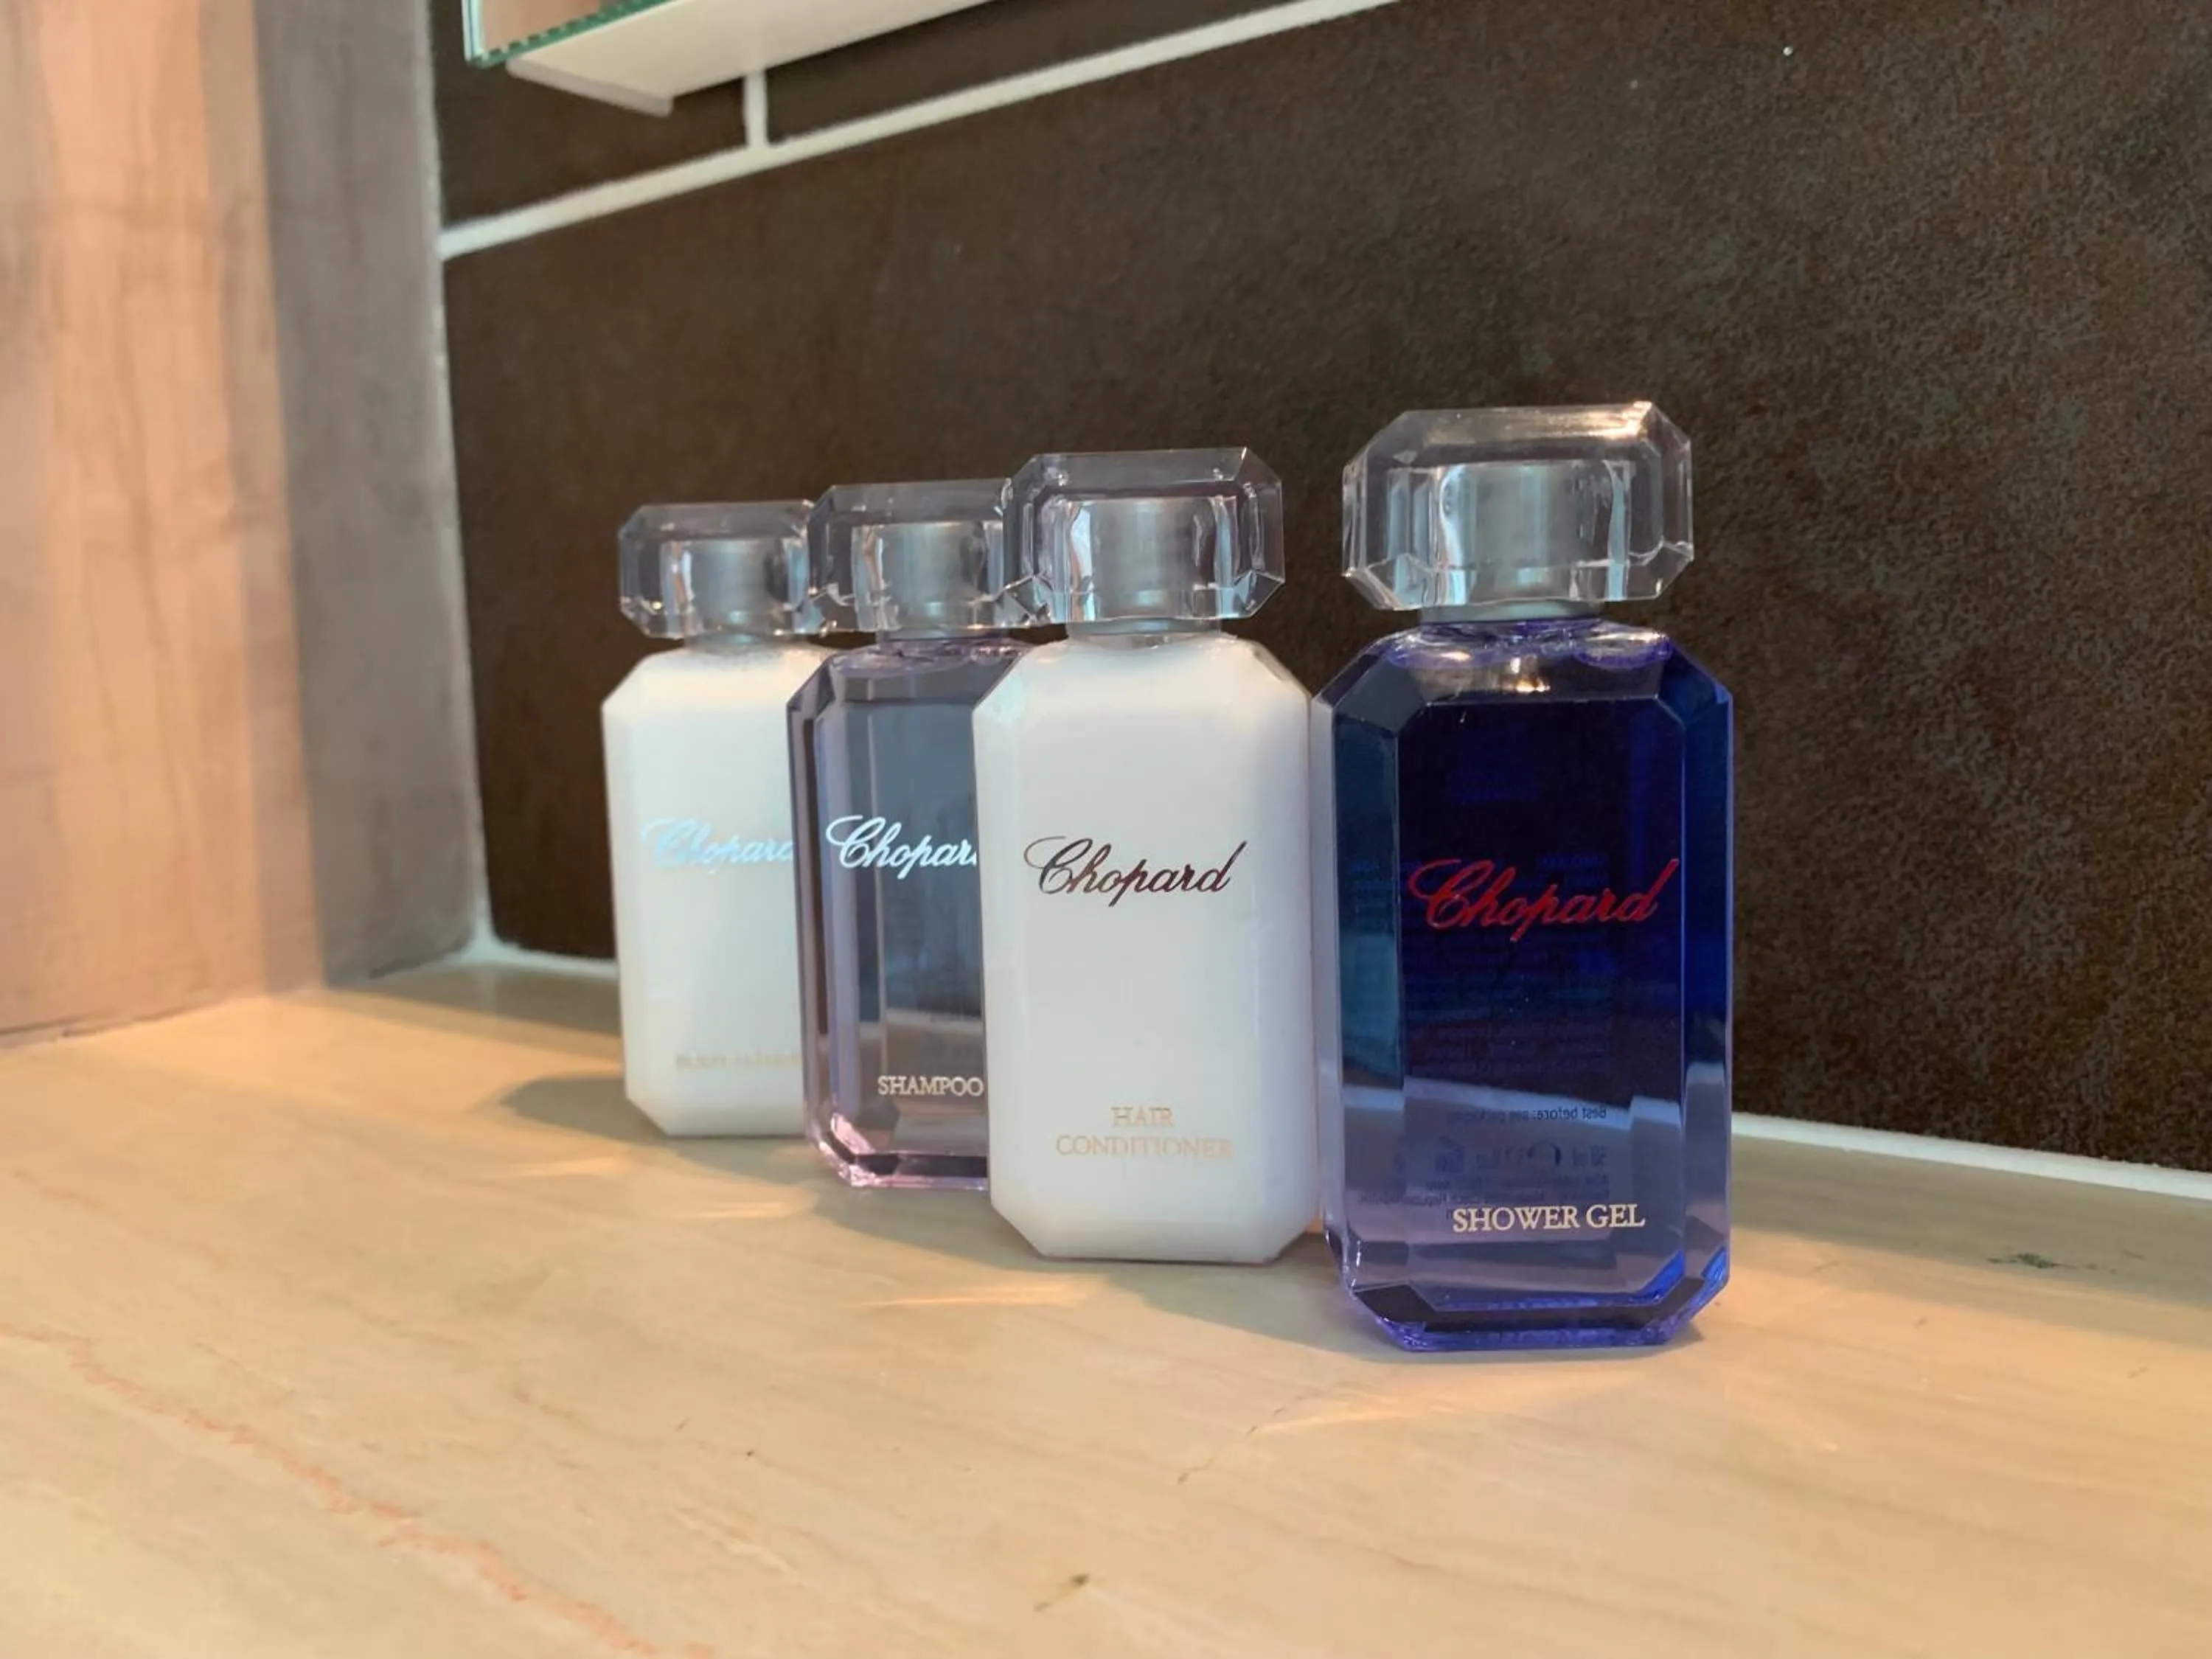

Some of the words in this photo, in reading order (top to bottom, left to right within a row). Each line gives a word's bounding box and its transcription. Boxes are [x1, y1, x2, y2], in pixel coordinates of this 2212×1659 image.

[826, 815, 977, 879] Chopar
[1023, 836, 1248, 907] Chopard
[1408, 858, 1679, 942] Chopard
[878, 1076, 984, 1097] SHAMPOO
[1112, 1107, 1175, 1127] HAIR
[1056, 1136, 1232, 1158] CONDITIONER
[1453, 1206, 1579, 1232] SHOWER
[1586, 1203, 1646, 1228] GEL
